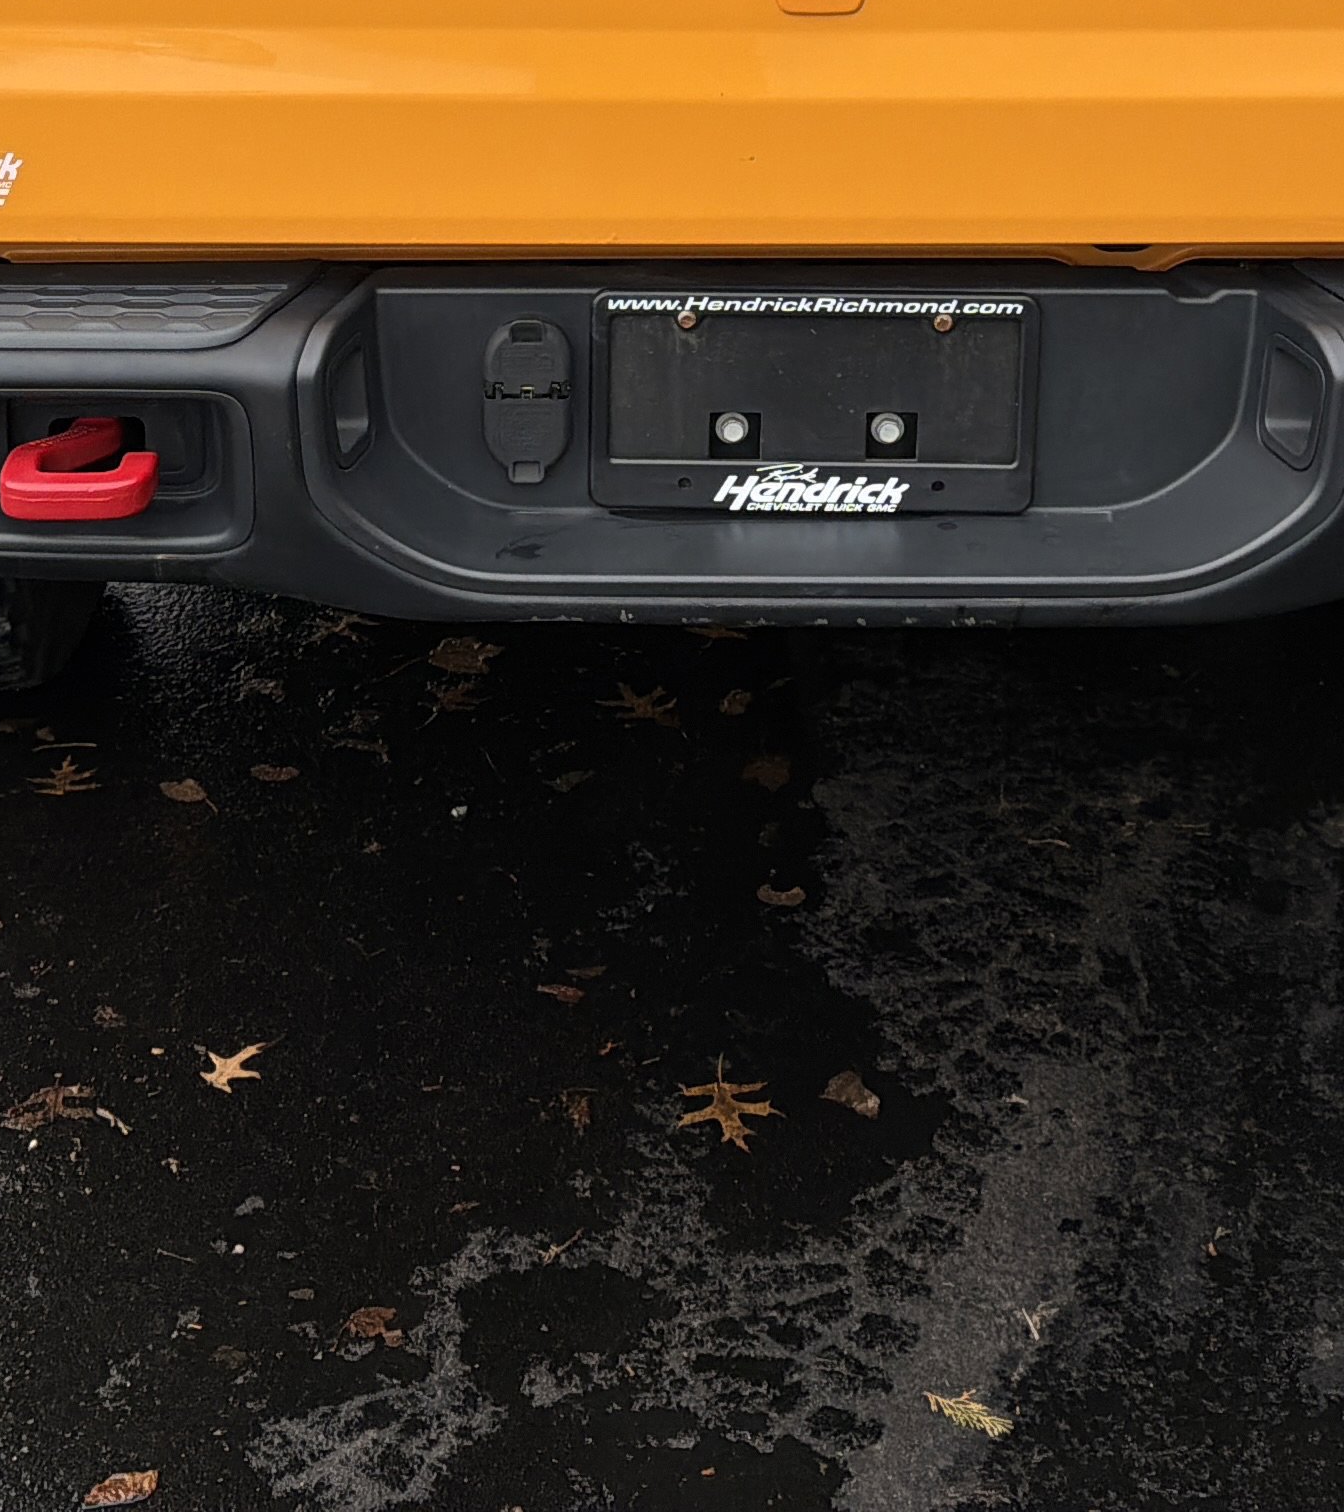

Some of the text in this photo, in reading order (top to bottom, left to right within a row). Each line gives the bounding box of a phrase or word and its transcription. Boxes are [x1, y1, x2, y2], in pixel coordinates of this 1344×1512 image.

[607, 296, 1025, 315] www.HendrickRichmond.com
[713, 475, 911, 511] Hendrick
[746, 502, 898, 513] CHEVROLET BUICK GMC
